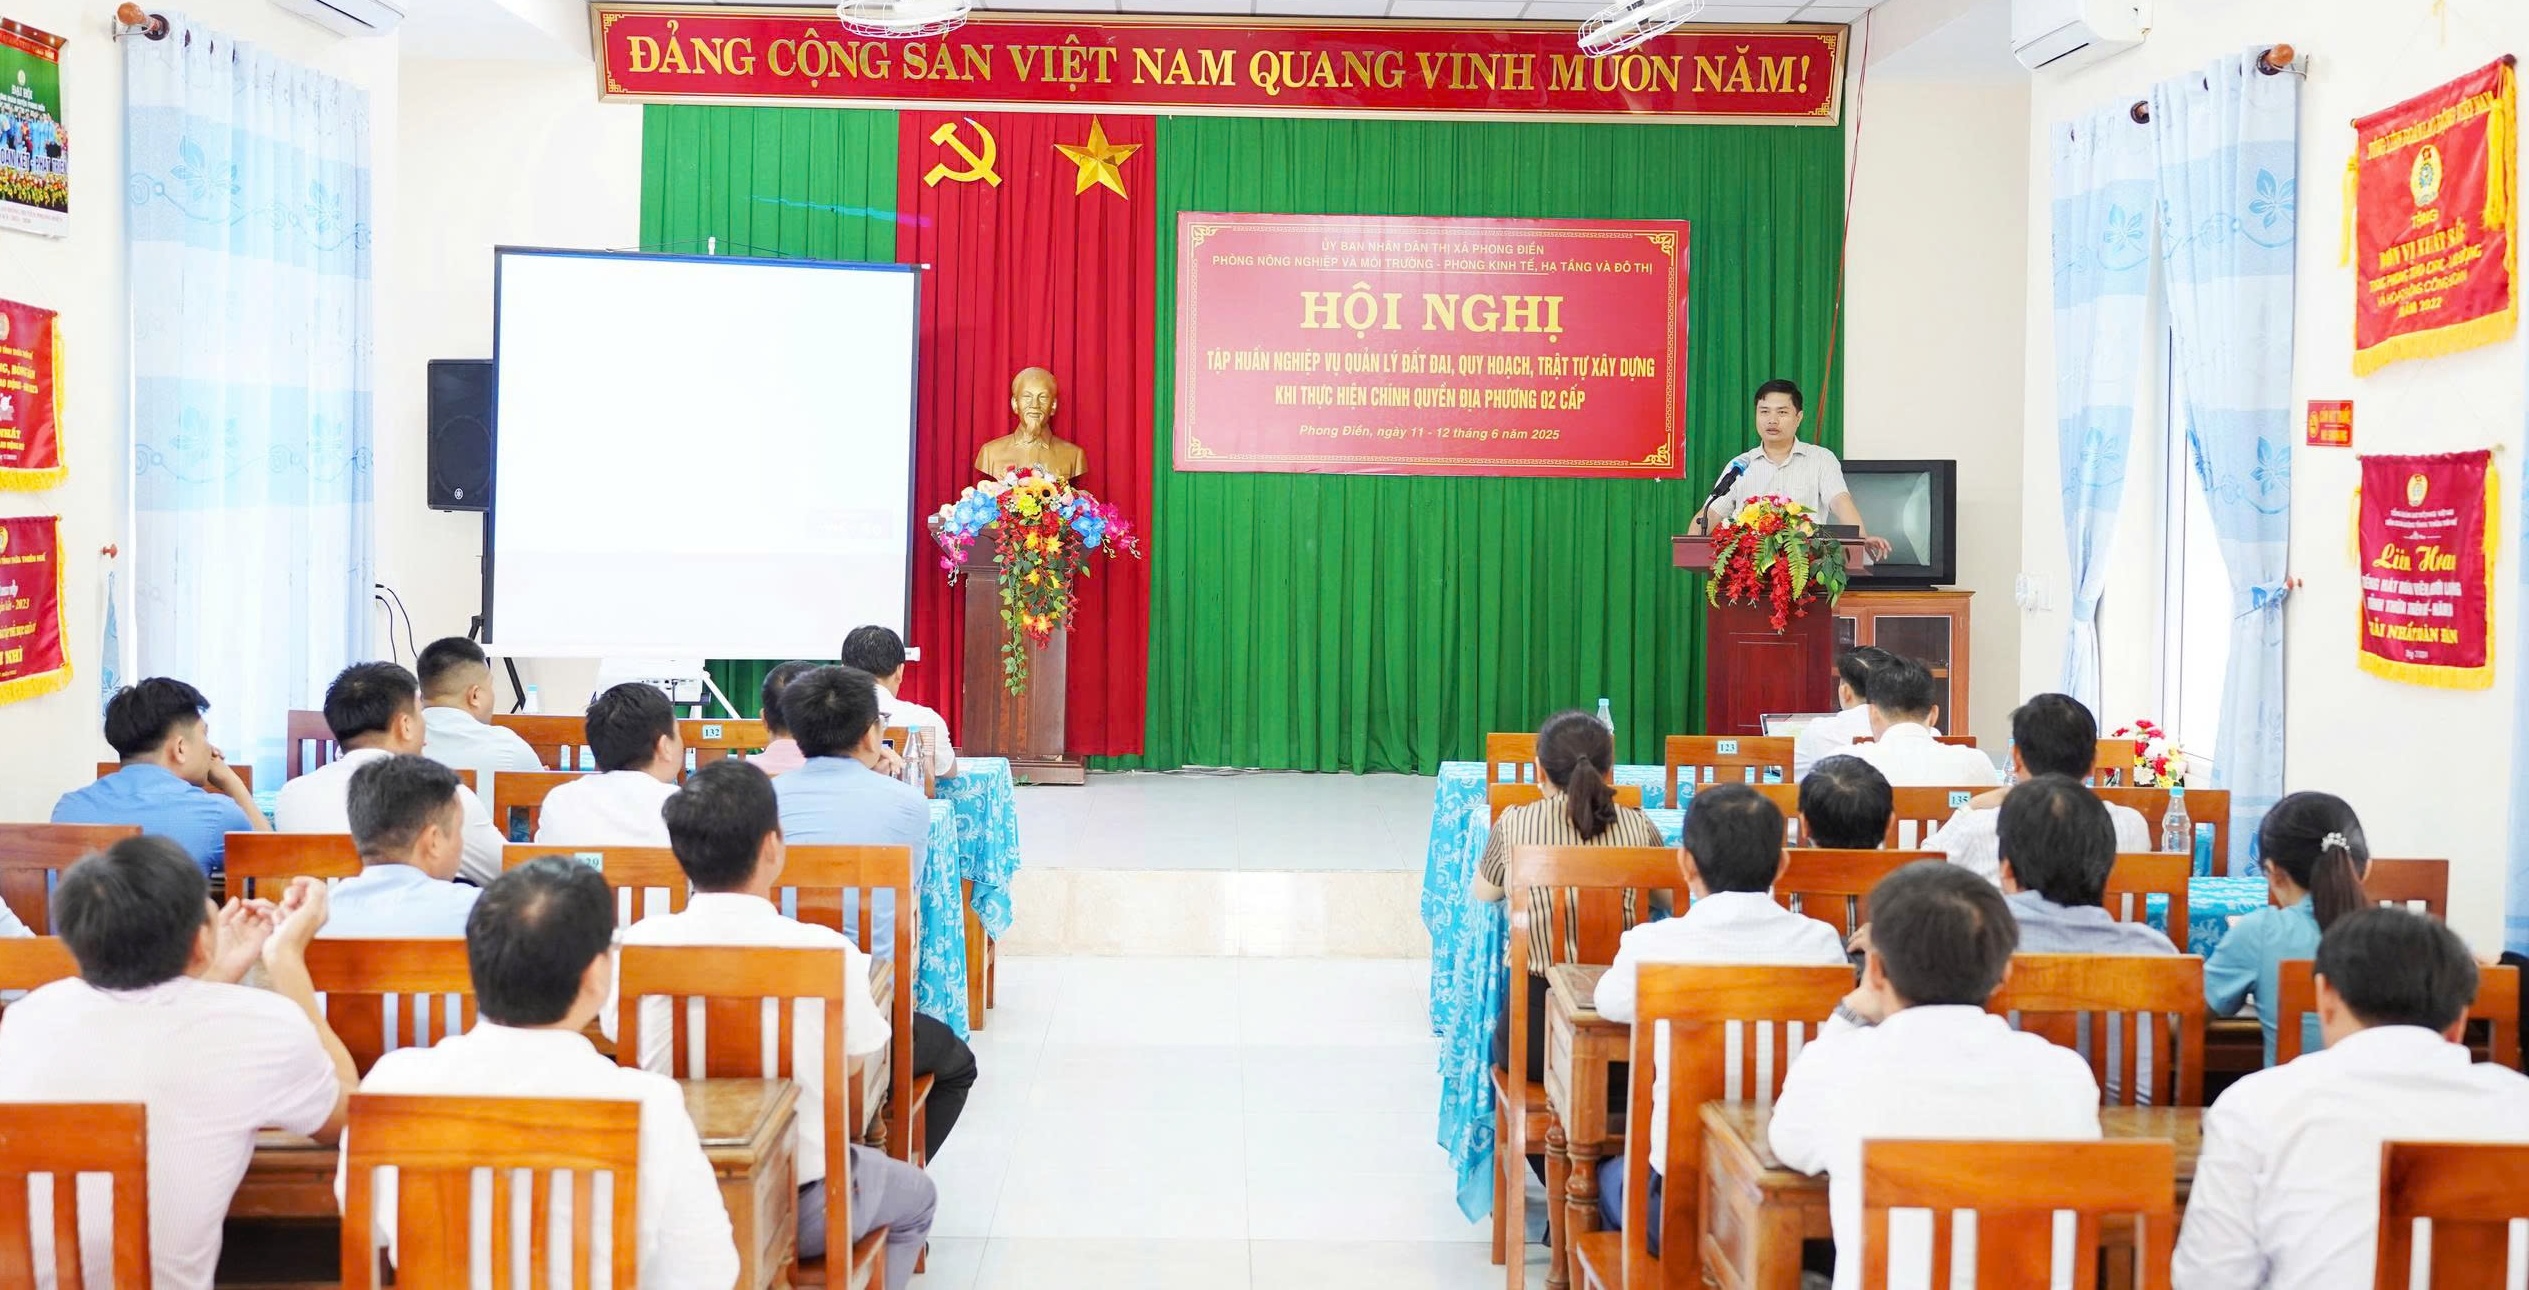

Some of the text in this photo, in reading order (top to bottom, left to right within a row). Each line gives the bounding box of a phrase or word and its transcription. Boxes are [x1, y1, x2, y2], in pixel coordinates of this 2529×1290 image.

[627, 20, 1810, 97] ĐẢNG CỘNG SẢN VIỆT NAM QUANG VINH MUÔN NĂM!
[1321, 237, 1337, 252] ỦY
[1340, 241, 1364, 252] BAN
[1368, 239, 1401, 252] NHÂN
[1404, 240, 1428, 253] DÂN
[1431, 243, 1450, 255] THỊ
[1453, 241, 1469, 254] XÃ
[1473, 243, 1514, 255] PHONG
[1212, 253, 1254, 267] PHÒNG
[1257, 254, 1291, 267] NÔNG
[1294, 255, 1338, 268] NGHIỆP
[1342, 256, 1357, 268] VÀ
[1360, 256, 1382, 269] MÔI
[1385, 256, 1434, 269] TRƯỜNG
[1444, 258, 1485, 270] PHÒNG
[1489, 260, 1516, 271] KINH
[1520, 257, 1538, 272] TẾ,
[1541, 260, 1558, 273] HẠ
[1560, 257, 1592, 273] TẦNG
[1595, 259, 1611, 273] VÀ
[1614, 260, 1631, 273] ĐÔ
[1634, 262, 1653, 275] THỊ
[1300, 280, 1564, 343] HỘI NGHỊ
[1207, 344, 1656, 382] TẬP HUẤN NGHIỆP VỤ QUẢN LÝ ĐẤT ĐAI, QUY HOẠCH, TRẬT TỰ XÂY DỰNG
[1275, 380, 1586, 412] KHI THỰC HIỆN CHÍNH QUYỀN ĐỊA PHƯƠNG 02 CẤP
[1299, 424, 1338, 438] Phong
[1376, 426, 1407, 440] ngày
[1410, 426, 1424, 437] 11
[1436, 427, 1449, 438] 12
[1453, 427, 1488, 441] tháng
[1491, 429, 1498, 439] 6
[1501, 429, 1528, 440] năm
[1530, 429, 1560, 440] 2025
[705, 728, 720, 737] 132
[1720, 743, 1735, 752] 123
